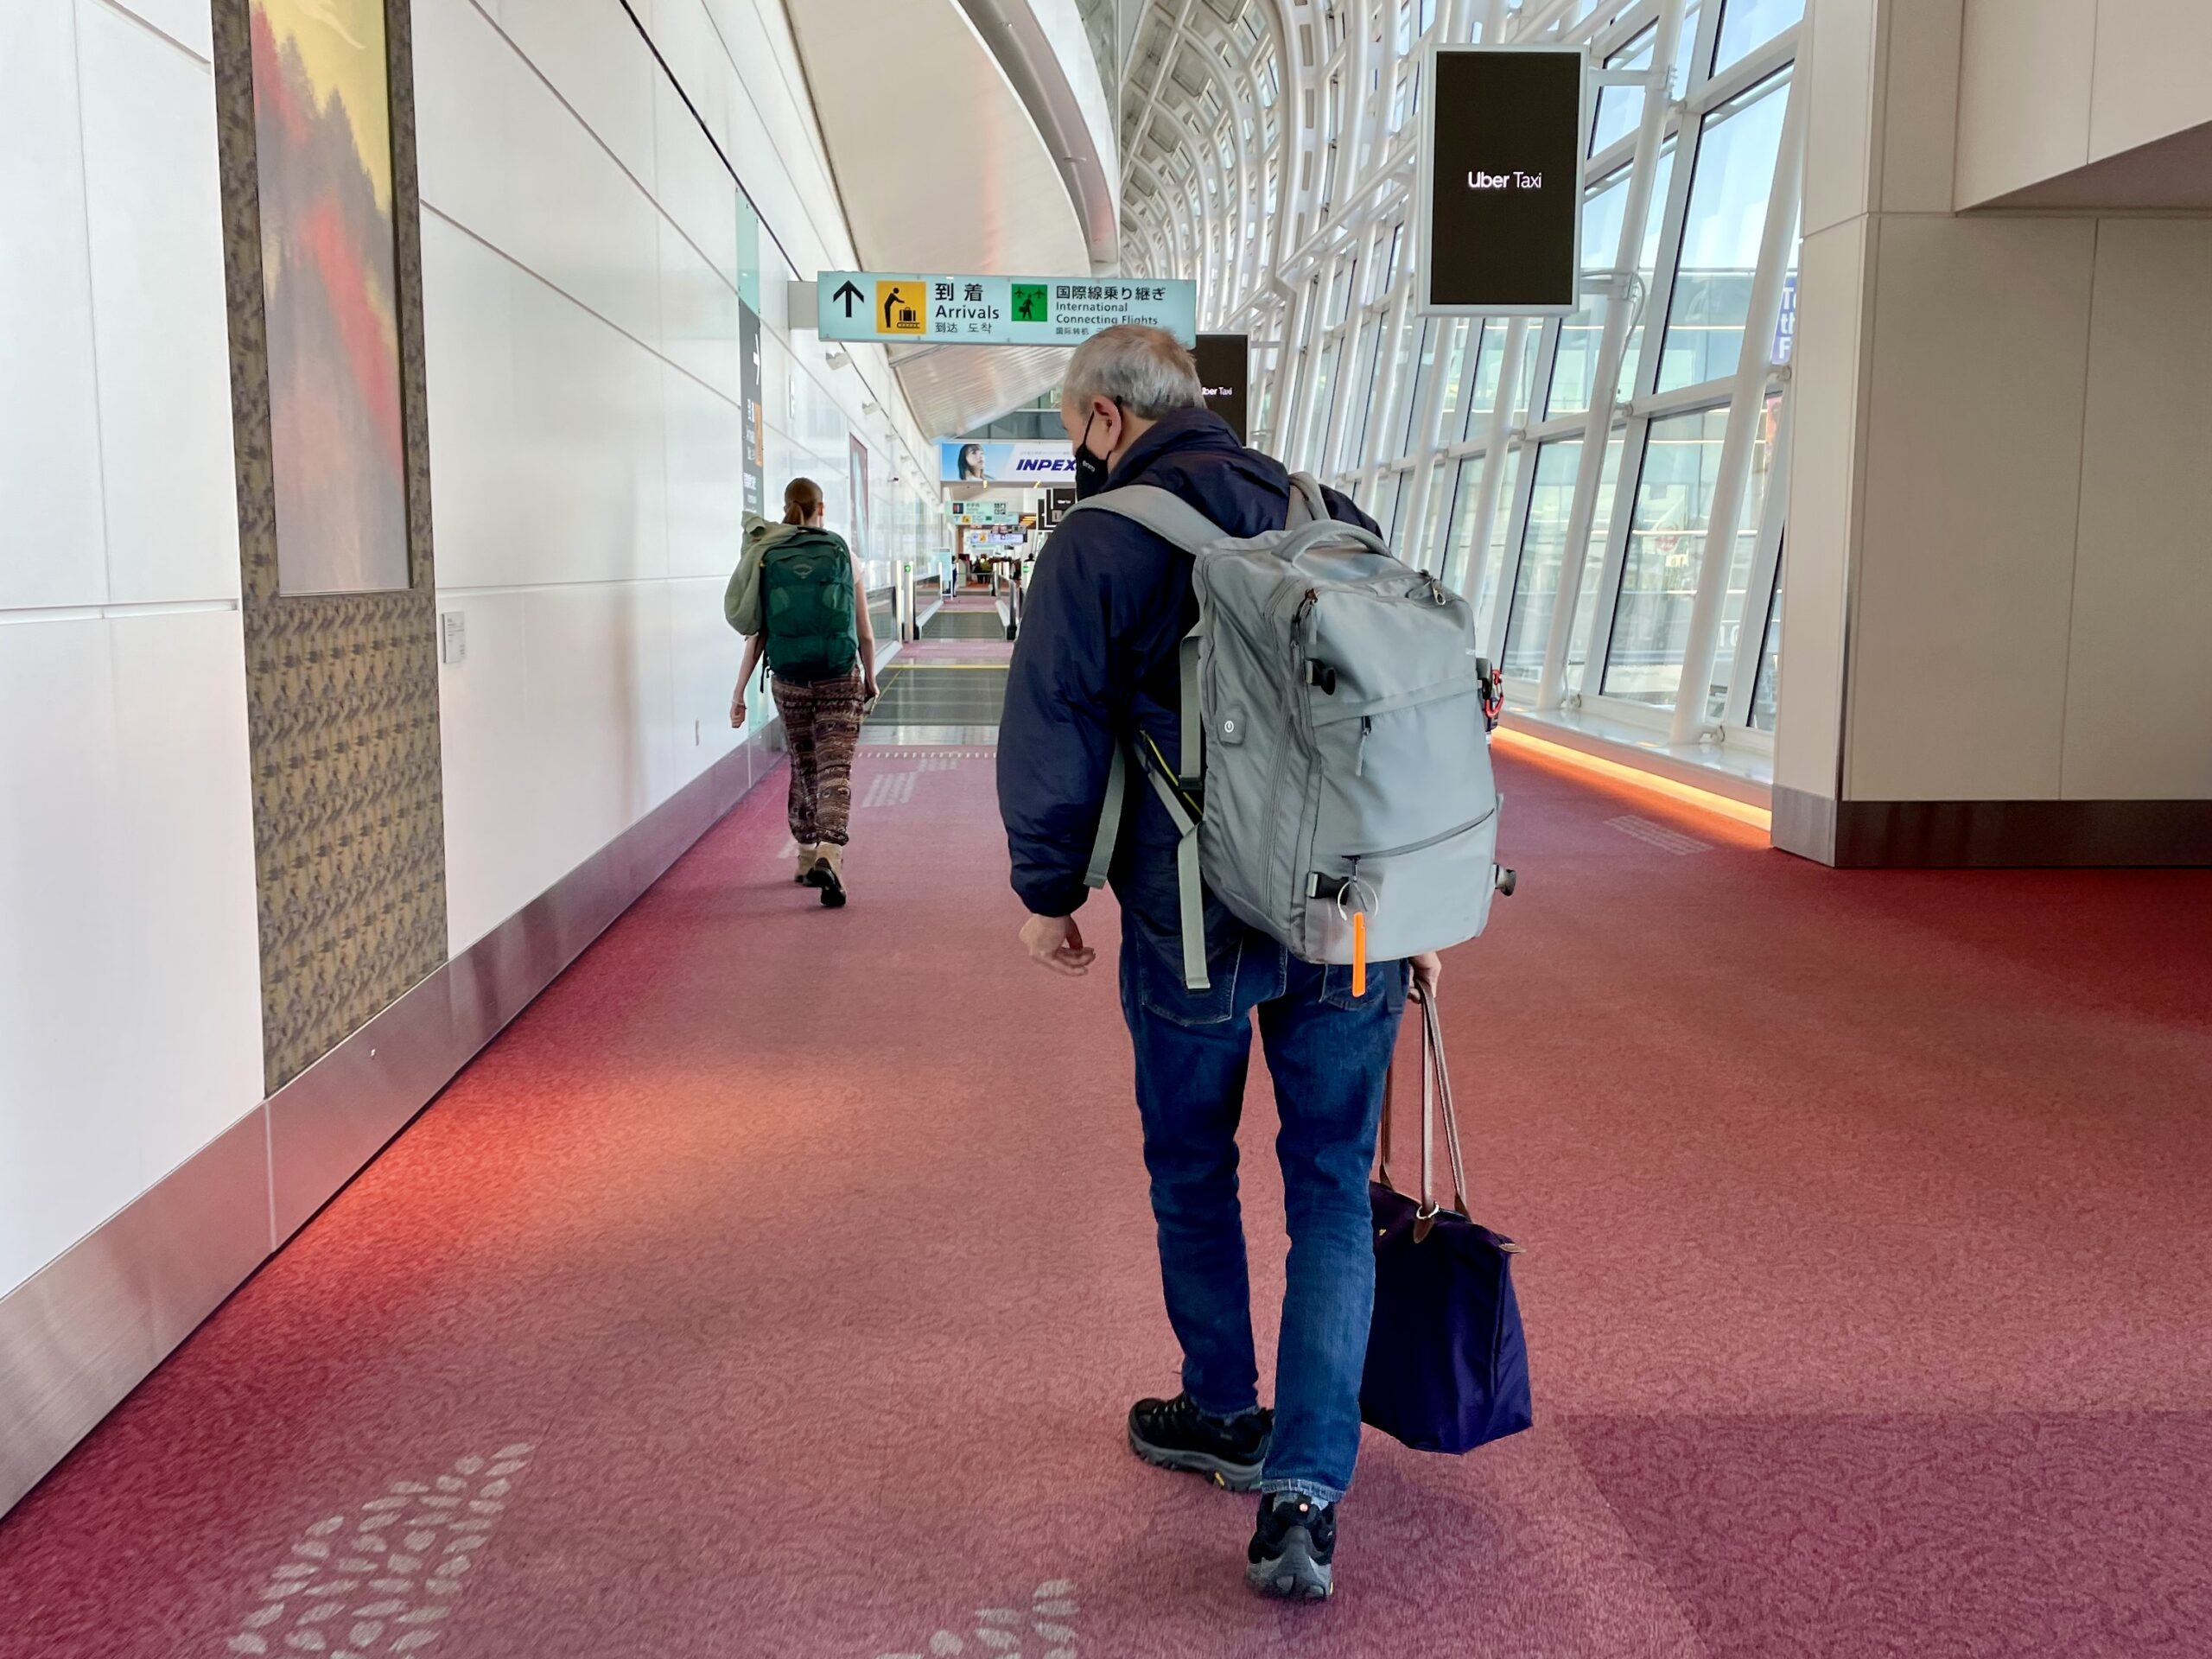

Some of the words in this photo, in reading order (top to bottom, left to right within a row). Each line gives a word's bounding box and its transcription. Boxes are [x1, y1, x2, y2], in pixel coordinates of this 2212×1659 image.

[1468, 171, 1510, 188] Uber
[1513, 171, 1542, 188] Taxi
[1056, 285, 1166, 301] 国際線乗り継ぎ
[935, 305, 1000, 319] Arrivals
[1056, 302, 1128, 312] International
[1056, 314, 1118, 325] Connecting
[1122, 315, 1158, 326] Flights
[935, 322, 958, 334] 到达
[967, 322, 992, 334] 도착
[1016, 459, 1077, 471] INPEX
